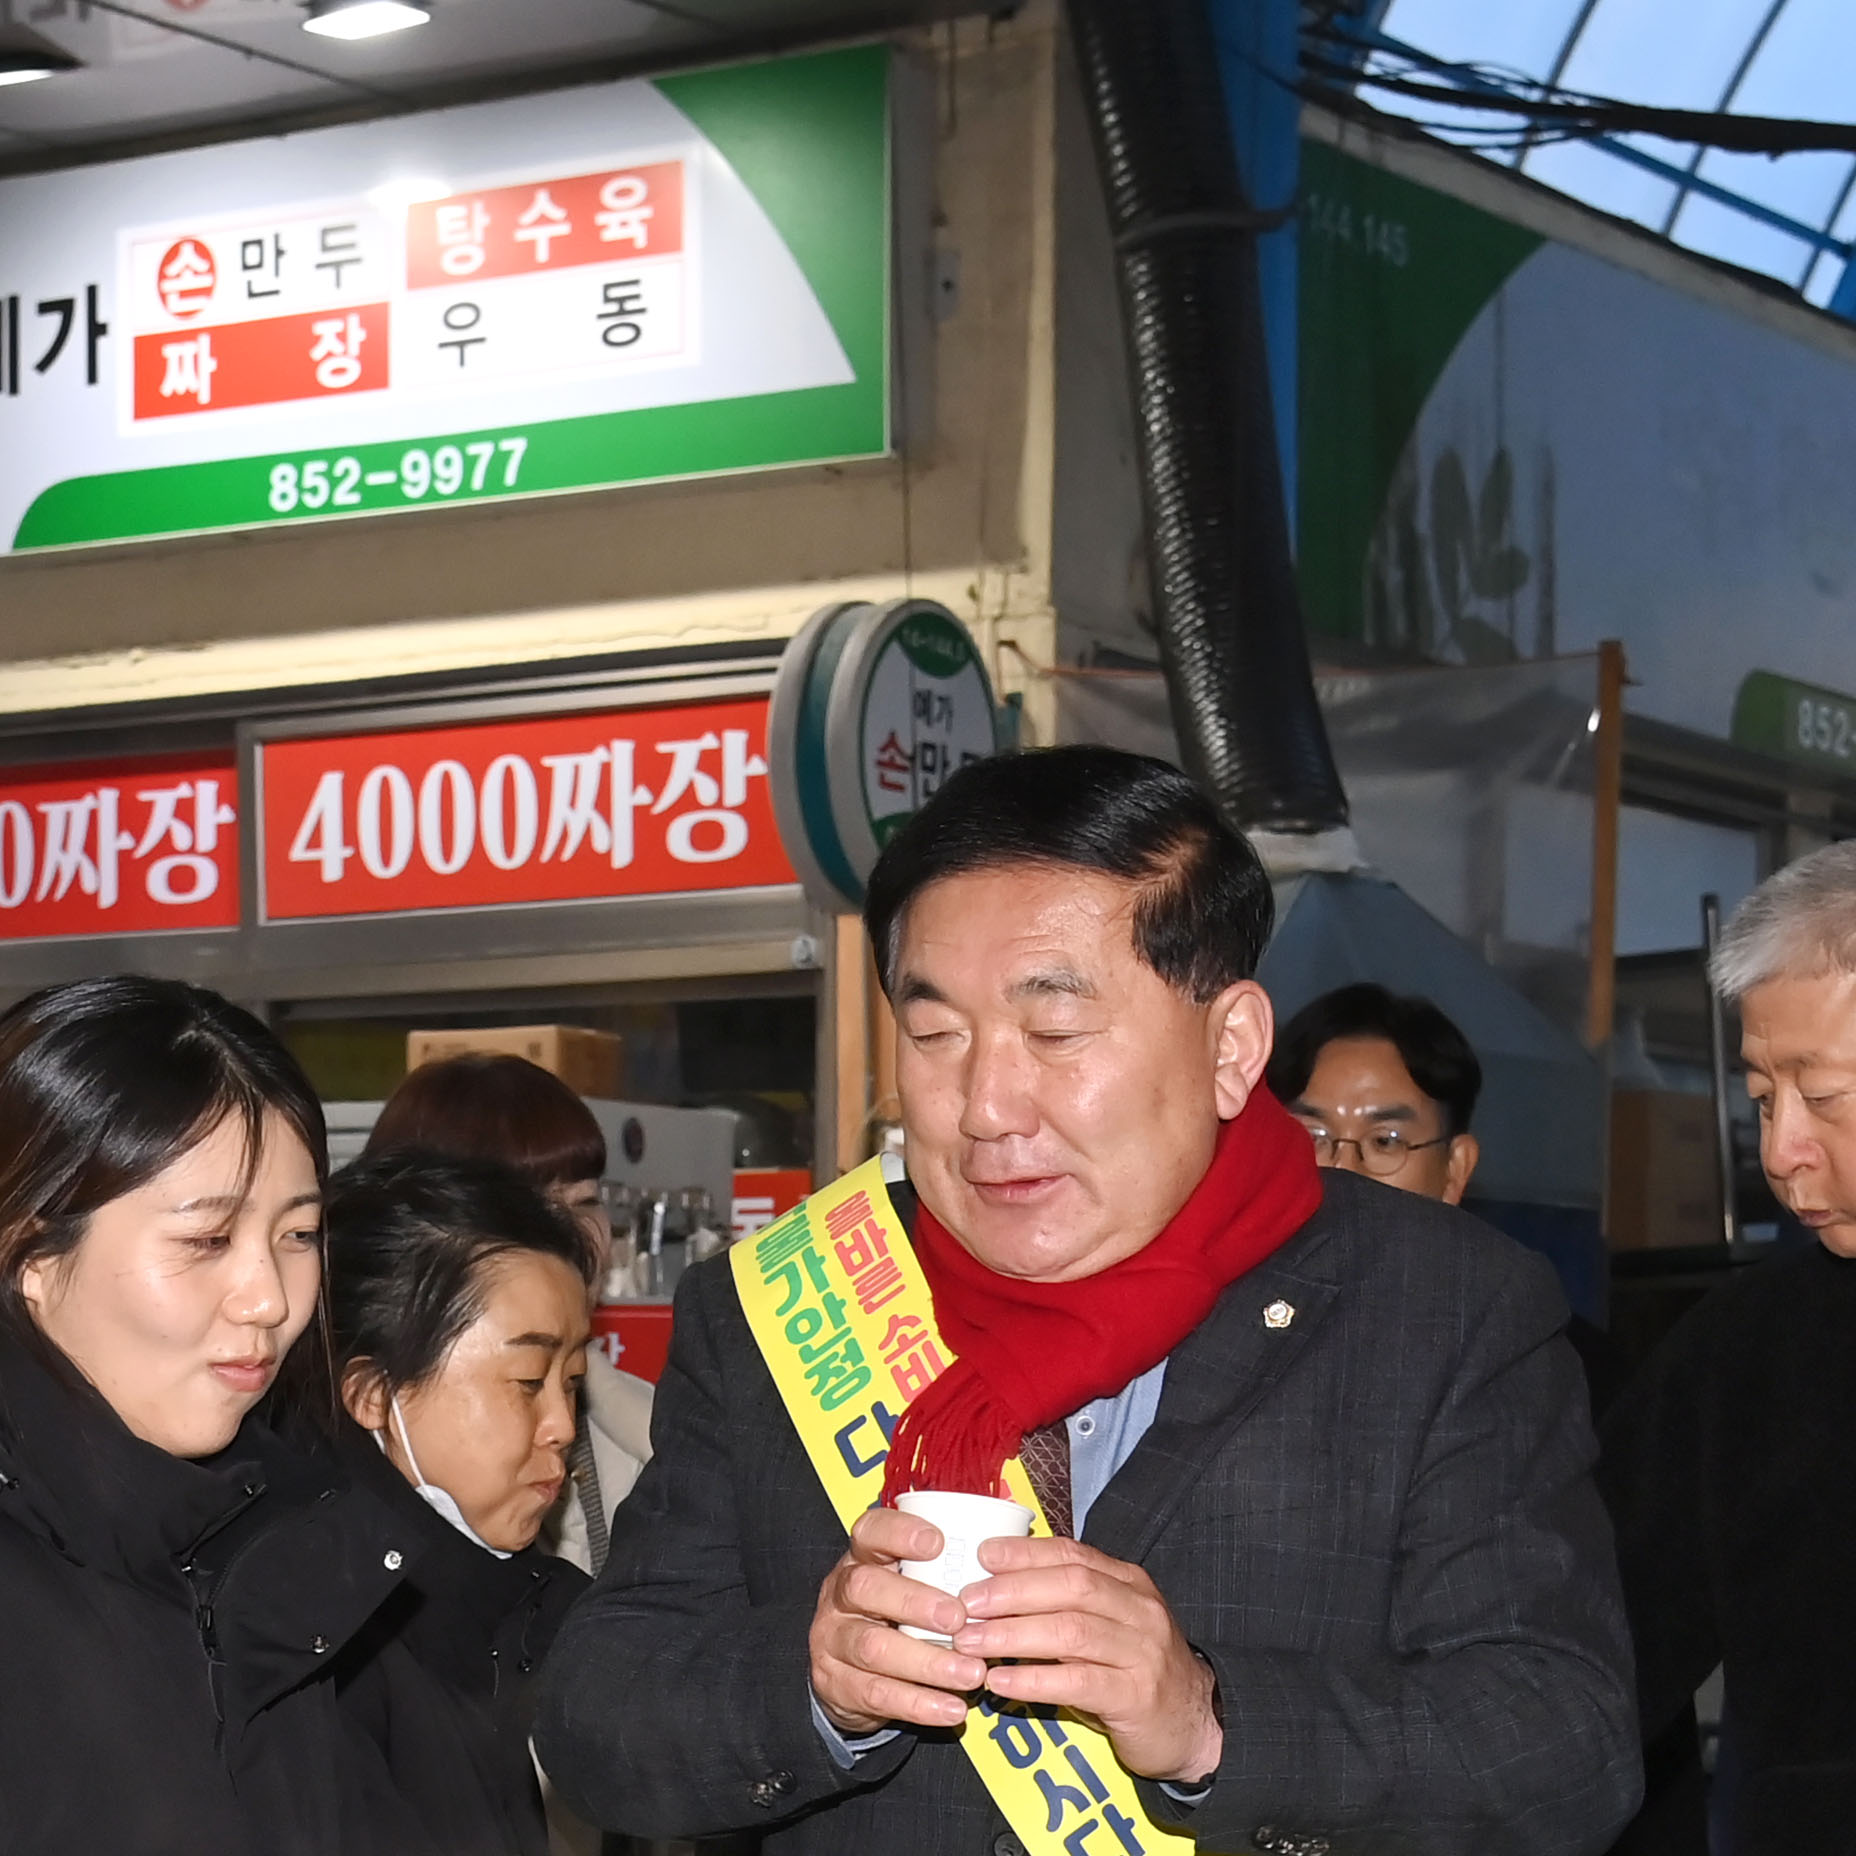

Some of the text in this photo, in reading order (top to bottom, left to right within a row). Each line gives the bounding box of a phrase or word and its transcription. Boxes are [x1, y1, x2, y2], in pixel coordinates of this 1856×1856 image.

[434, 174, 654, 276] 탕수육
[159, 312, 366, 406] 짜장
[436, 276, 648, 368] 우동
[268, 437, 528, 515] 852-9977
[288, 729, 770, 884] 4000짜장
